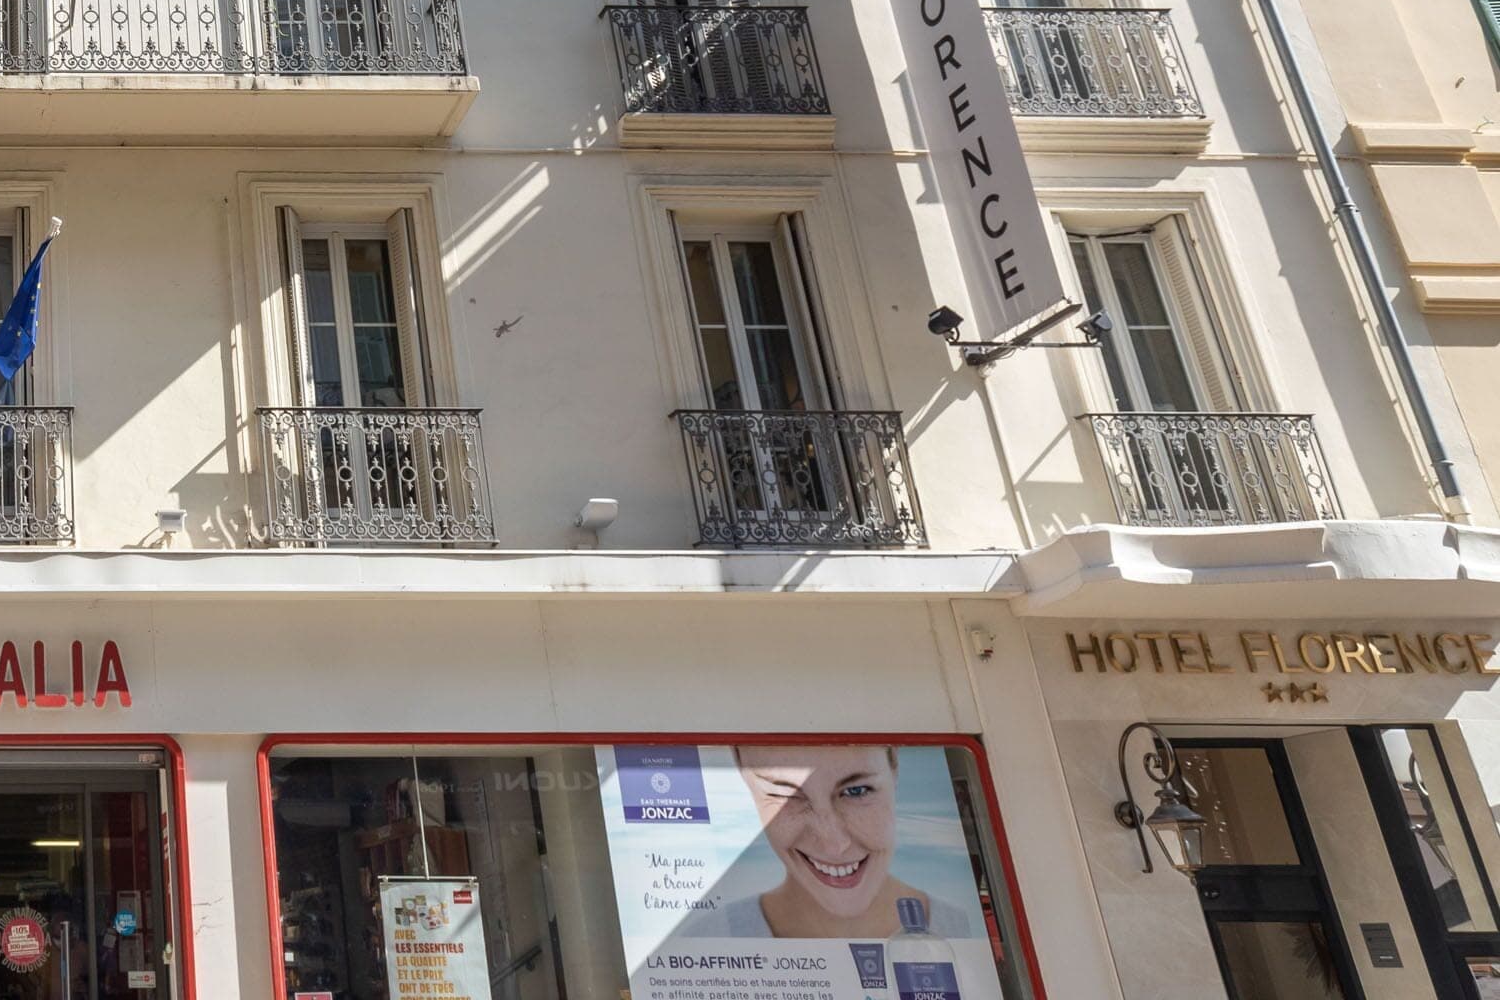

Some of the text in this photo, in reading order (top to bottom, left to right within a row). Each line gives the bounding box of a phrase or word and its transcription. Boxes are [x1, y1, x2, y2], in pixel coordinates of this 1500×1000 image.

[1065, 631, 1500, 675] HOTEL FLORENCE
[641, 807, 693, 820] JONZAC
[674, 857, 706, 876] peau
[652, 875, 705, 890] a trouvé
[644, 893, 682, 910] l'âme
[394, 929, 416, 940] AVEC
[395, 942, 464, 954] LES ESSENTIELS
[396, 956, 408, 967] LA
[646, 956, 666, 969] LA
[772, 957, 827, 970] JONZAC
[397, 969, 444, 980] ET LE PRIX
[398, 982, 417, 994] ONT
[419, 982, 431, 994] DE
[649, 977, 831, 988] Des soins certifiés bio et haute tolérance
[651, 992, 664, 1000] en
[668, 990, 705, 1000] affinité
[709, 990, 749, 1000] parfaite
[754, 992, 778, 1000] avec
[782, 991, 816, 1000] toutes
